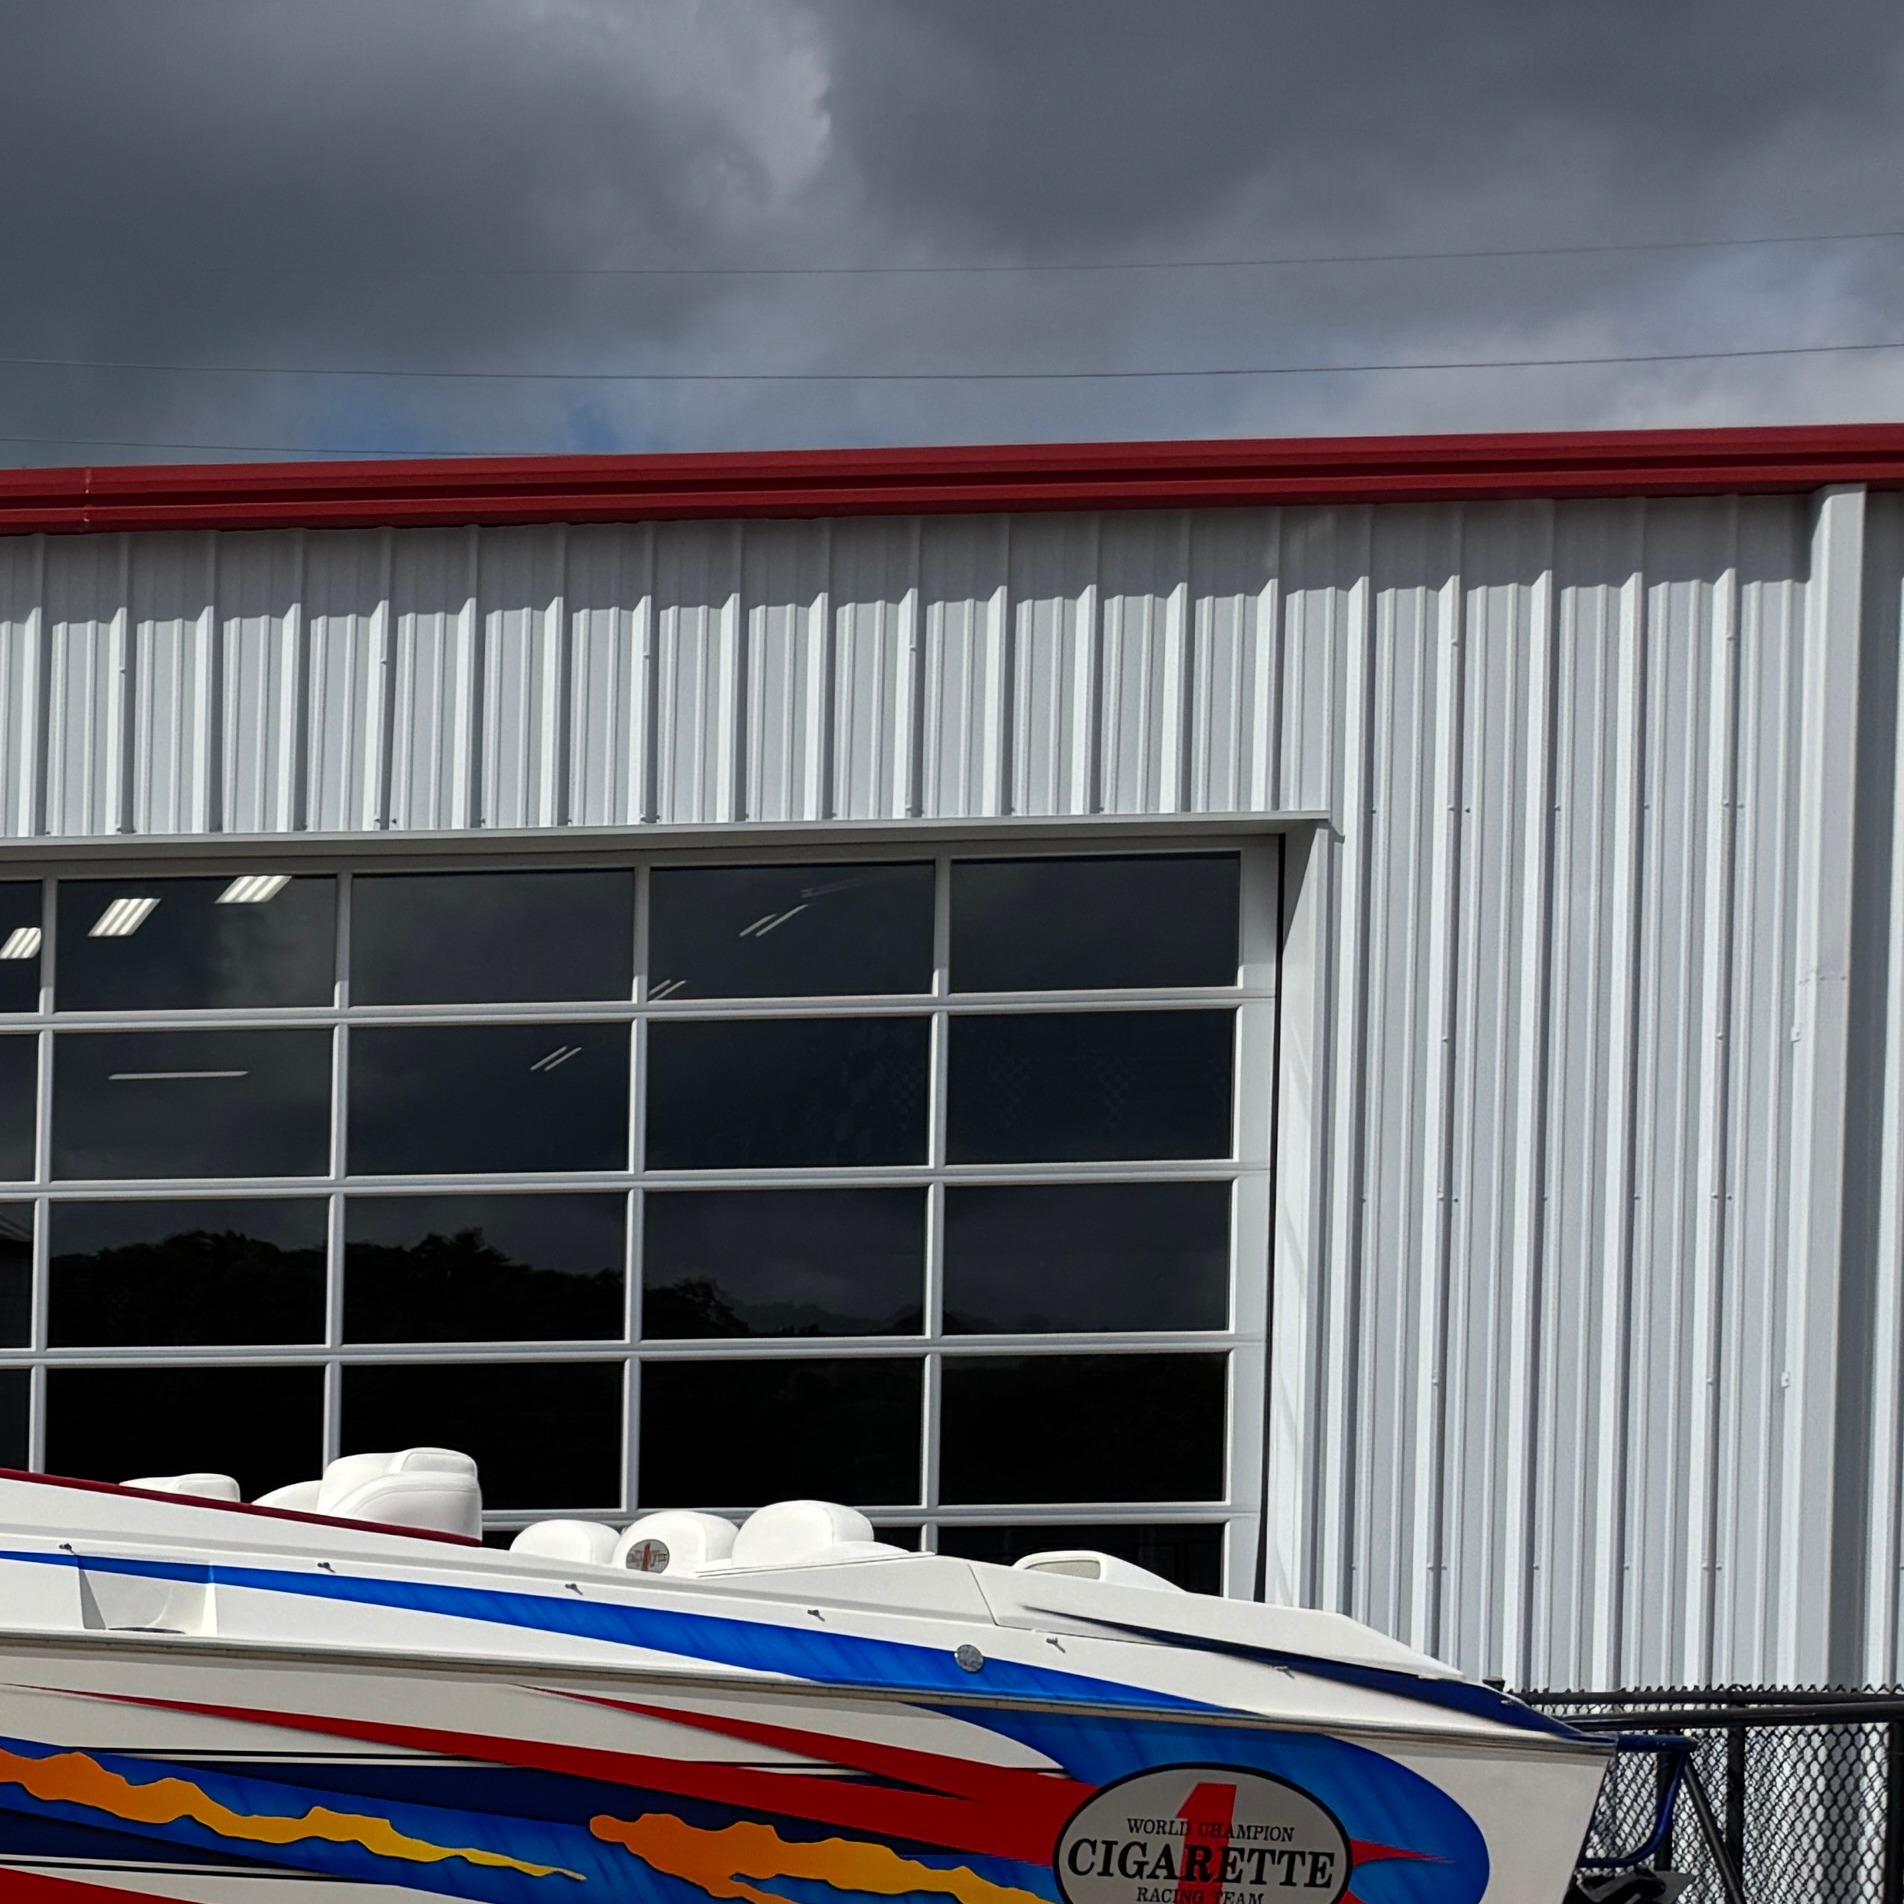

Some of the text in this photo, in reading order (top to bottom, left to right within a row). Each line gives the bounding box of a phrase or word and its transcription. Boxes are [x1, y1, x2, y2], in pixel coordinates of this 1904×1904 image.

[1127, 1818, 1295, 1842] WORLD CHAMPION
[1067, 1838, 1336, 1889] CIGARETTE
[1136, 1887, 1204, 1904] RACING
